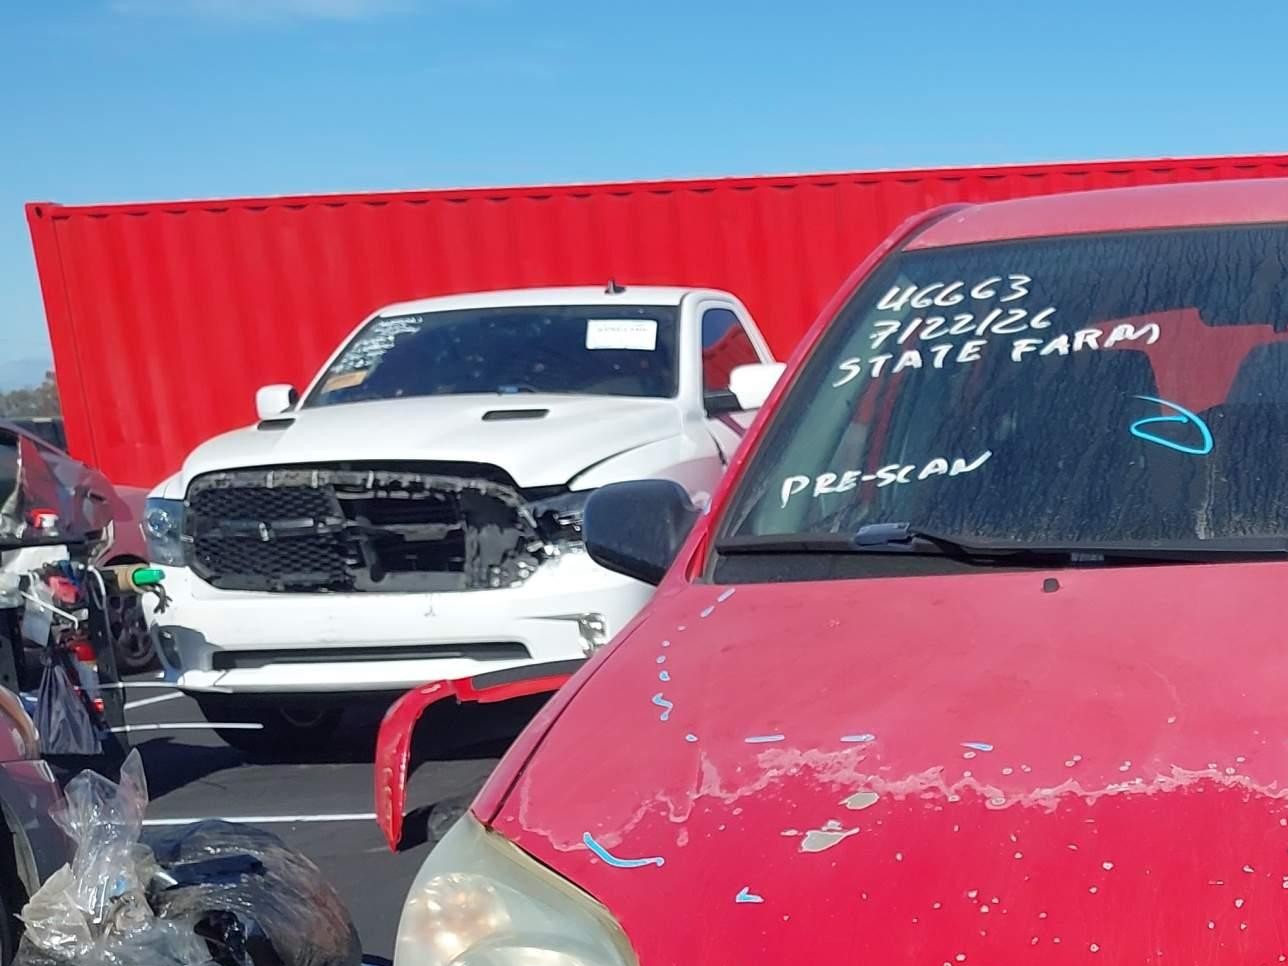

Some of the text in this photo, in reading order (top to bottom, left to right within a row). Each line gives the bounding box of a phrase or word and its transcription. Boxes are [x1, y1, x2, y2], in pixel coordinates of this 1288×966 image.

[877, 274, 1031, 311] 46663
[869, 307, 1056, 349] 7/22/26
[832, 323, 1160, 388] STATE FARM
[781, 452, 992, 508] PRE-SCAN
